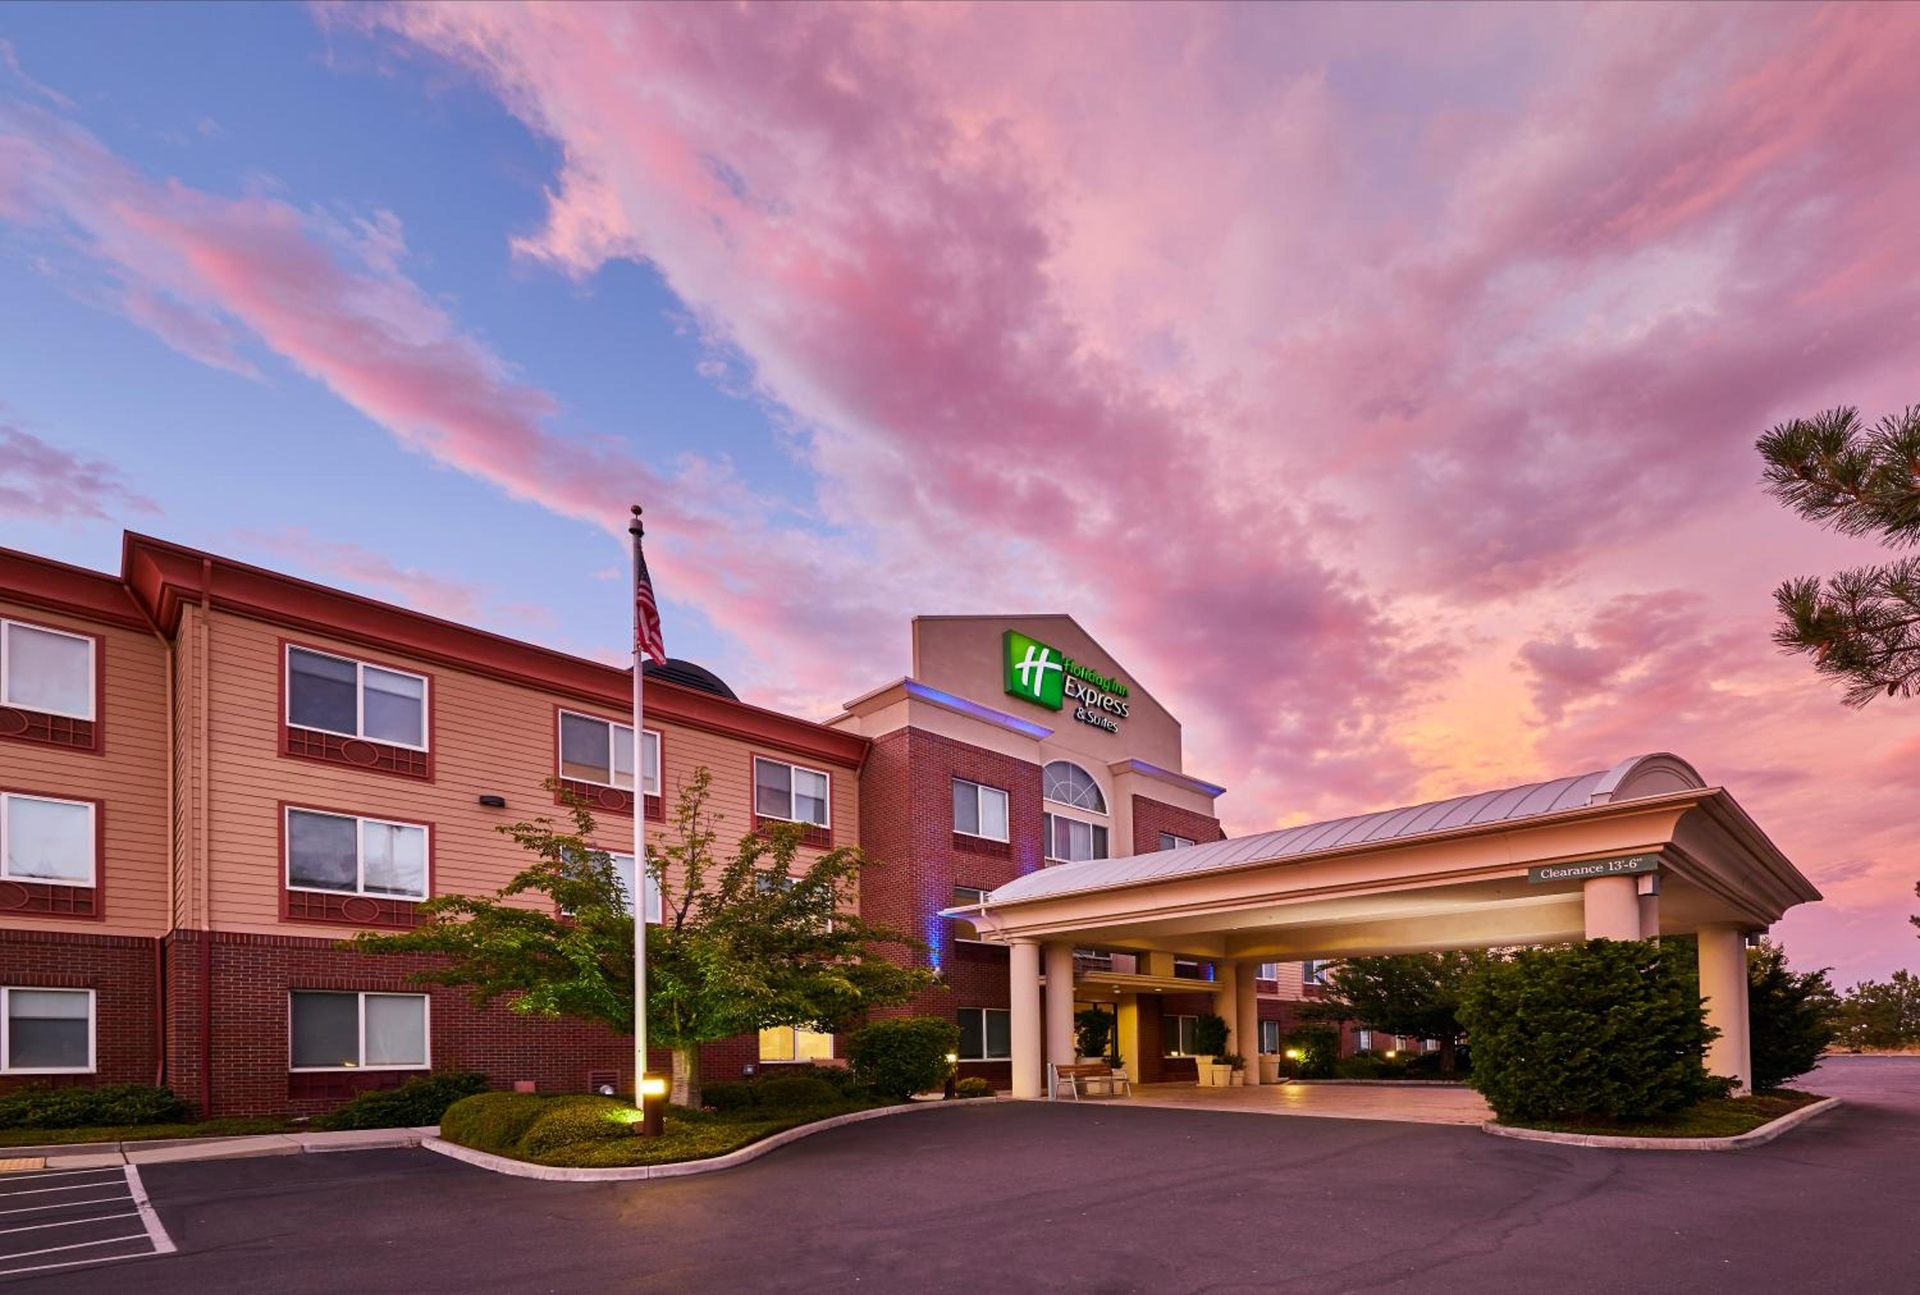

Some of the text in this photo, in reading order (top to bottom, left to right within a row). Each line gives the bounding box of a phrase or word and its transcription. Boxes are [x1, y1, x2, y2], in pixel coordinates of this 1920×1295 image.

[1064, 658, 1128, 696] Holiday Inn
[1065, 675, 1130, 718] Express
[1076, 707, 1119, 733] & Suites
[1540, 864, 1603, 878] Clearance
